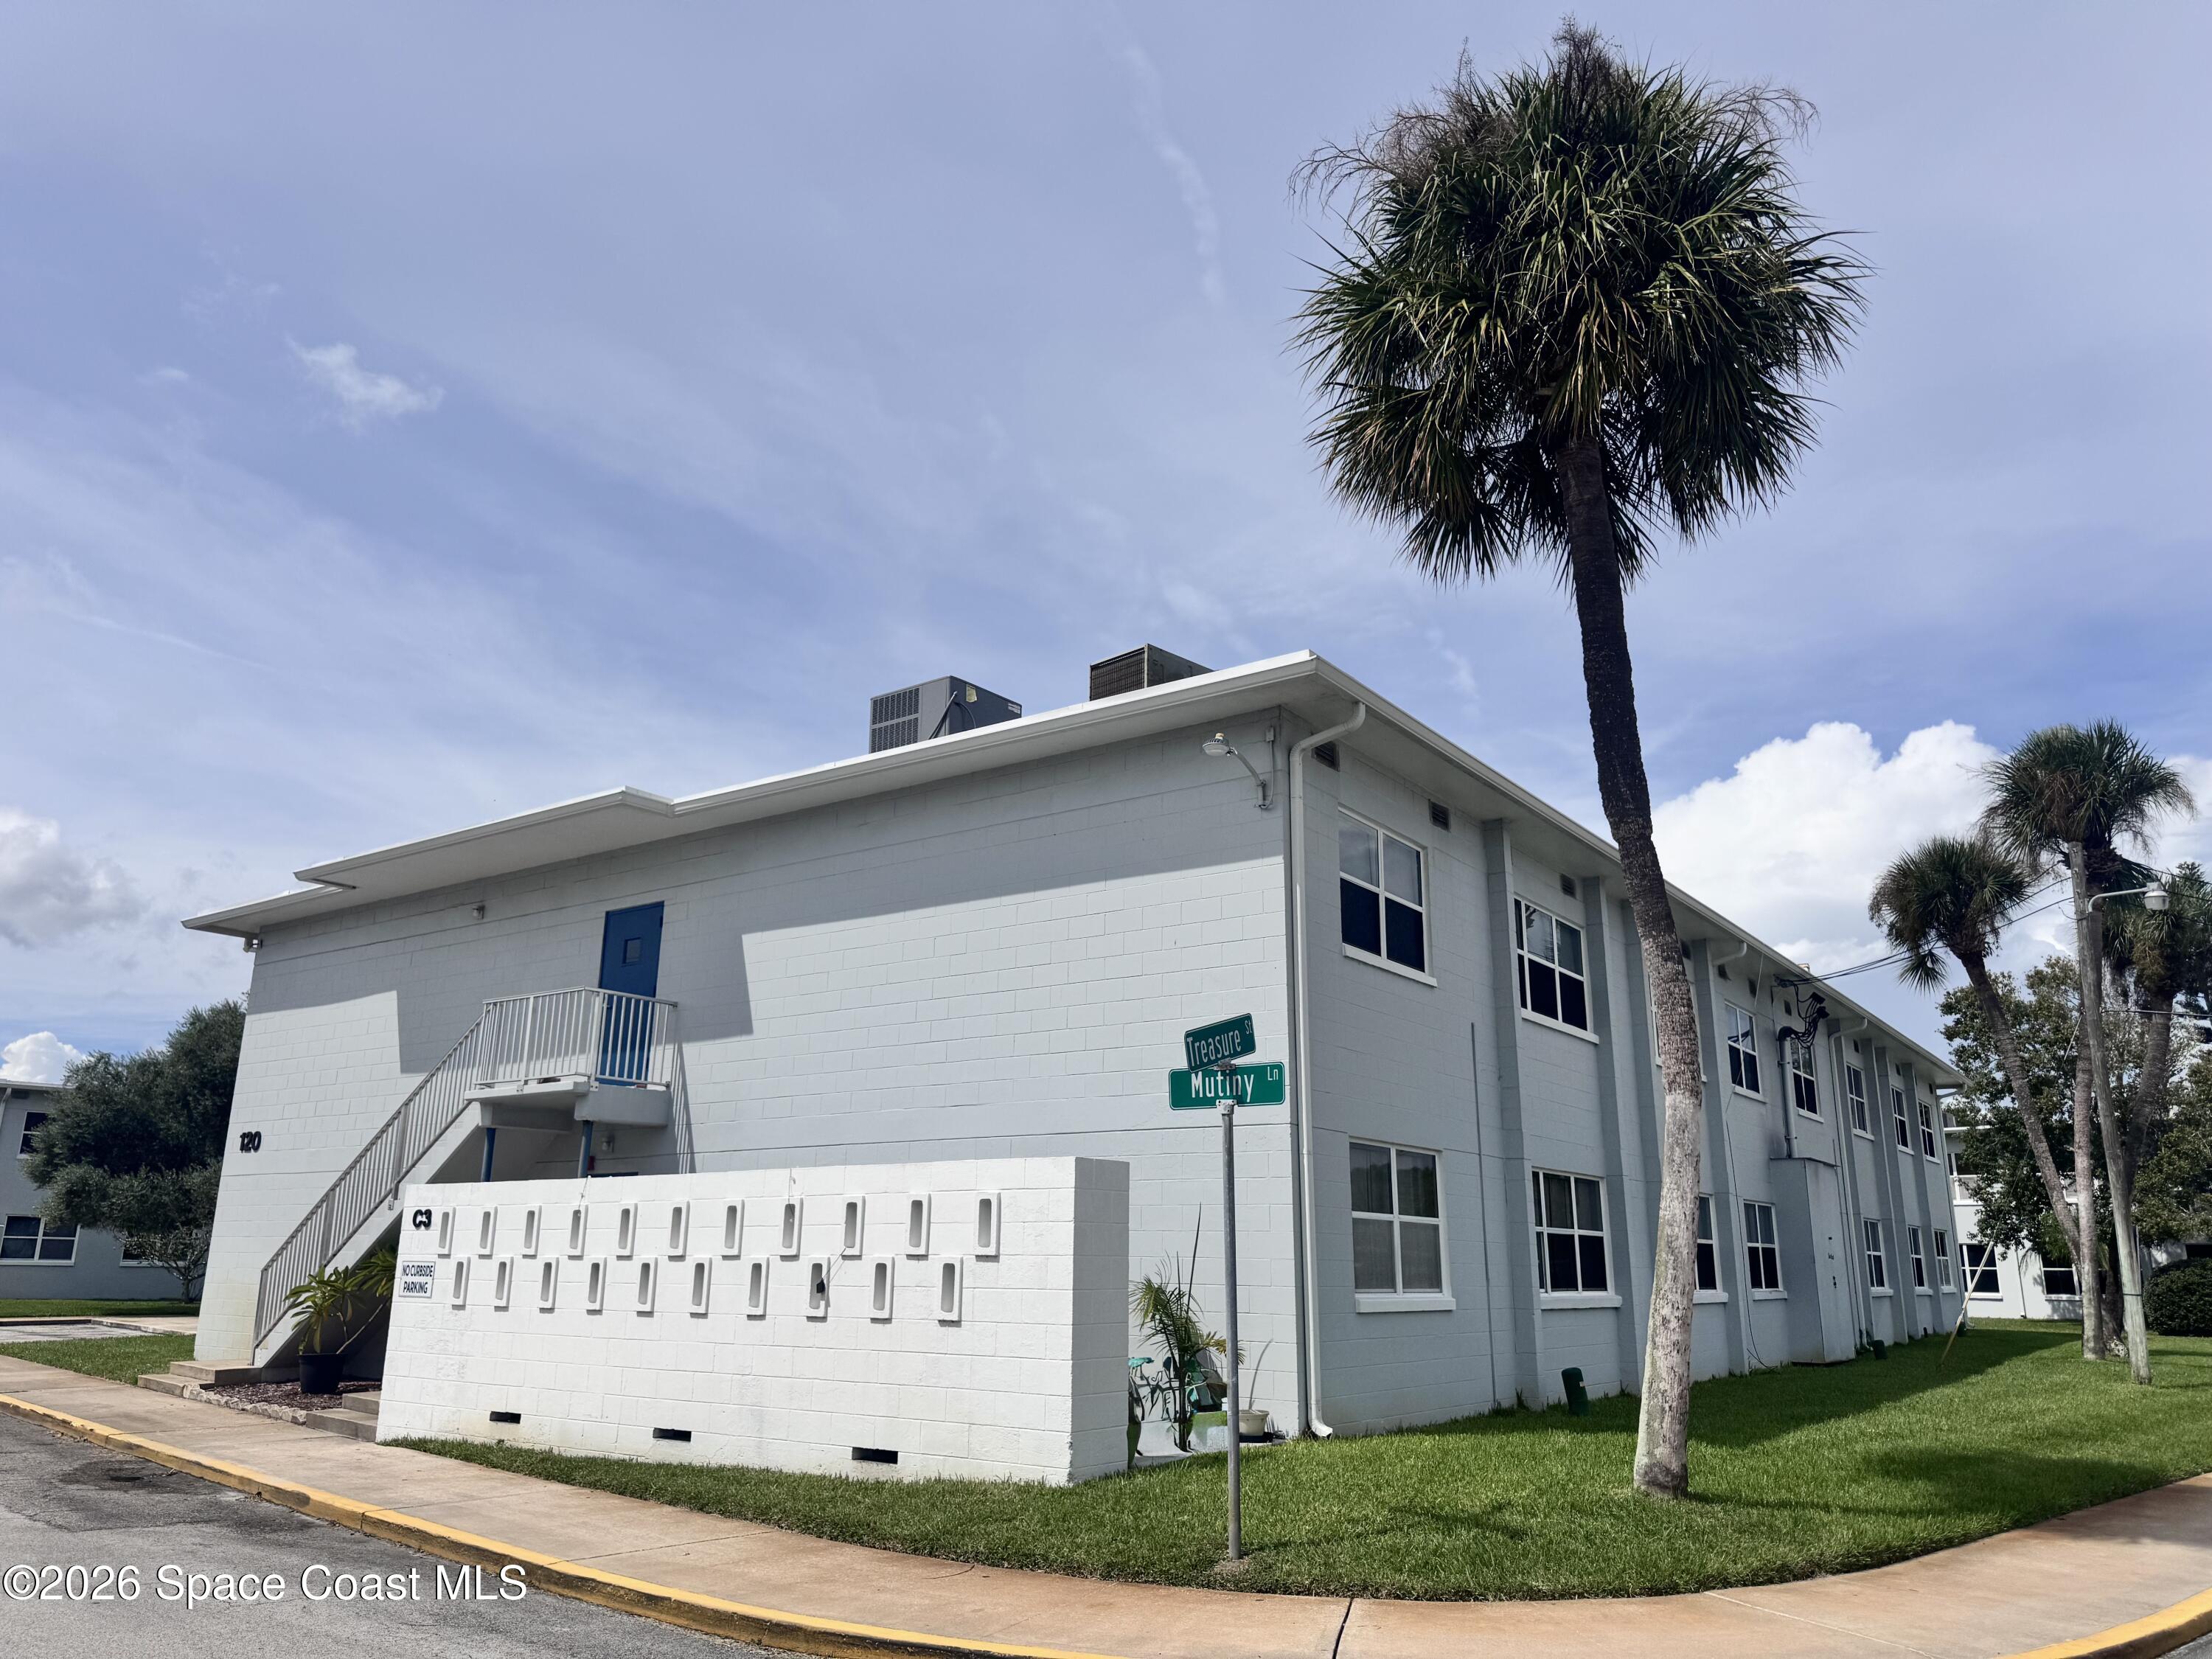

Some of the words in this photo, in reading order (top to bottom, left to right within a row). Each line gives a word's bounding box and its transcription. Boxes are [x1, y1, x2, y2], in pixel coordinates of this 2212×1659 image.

[1186, 1029, 1242, 1067] Treasure
[1245, 1020, 1252, 1034] St
[1191, 1070, 1254, 1102] Mutiny
[1267, 1066, 1279, 1081] Ln
[240, 1131, 262, 1152] 120
[412, 1208, 432, 1228] C3
[403, 1265, 410, 1276] NO
[411, 1265, 433, 1277] CURBSIDE
[403, 1281, 428, 1293] PARKING
